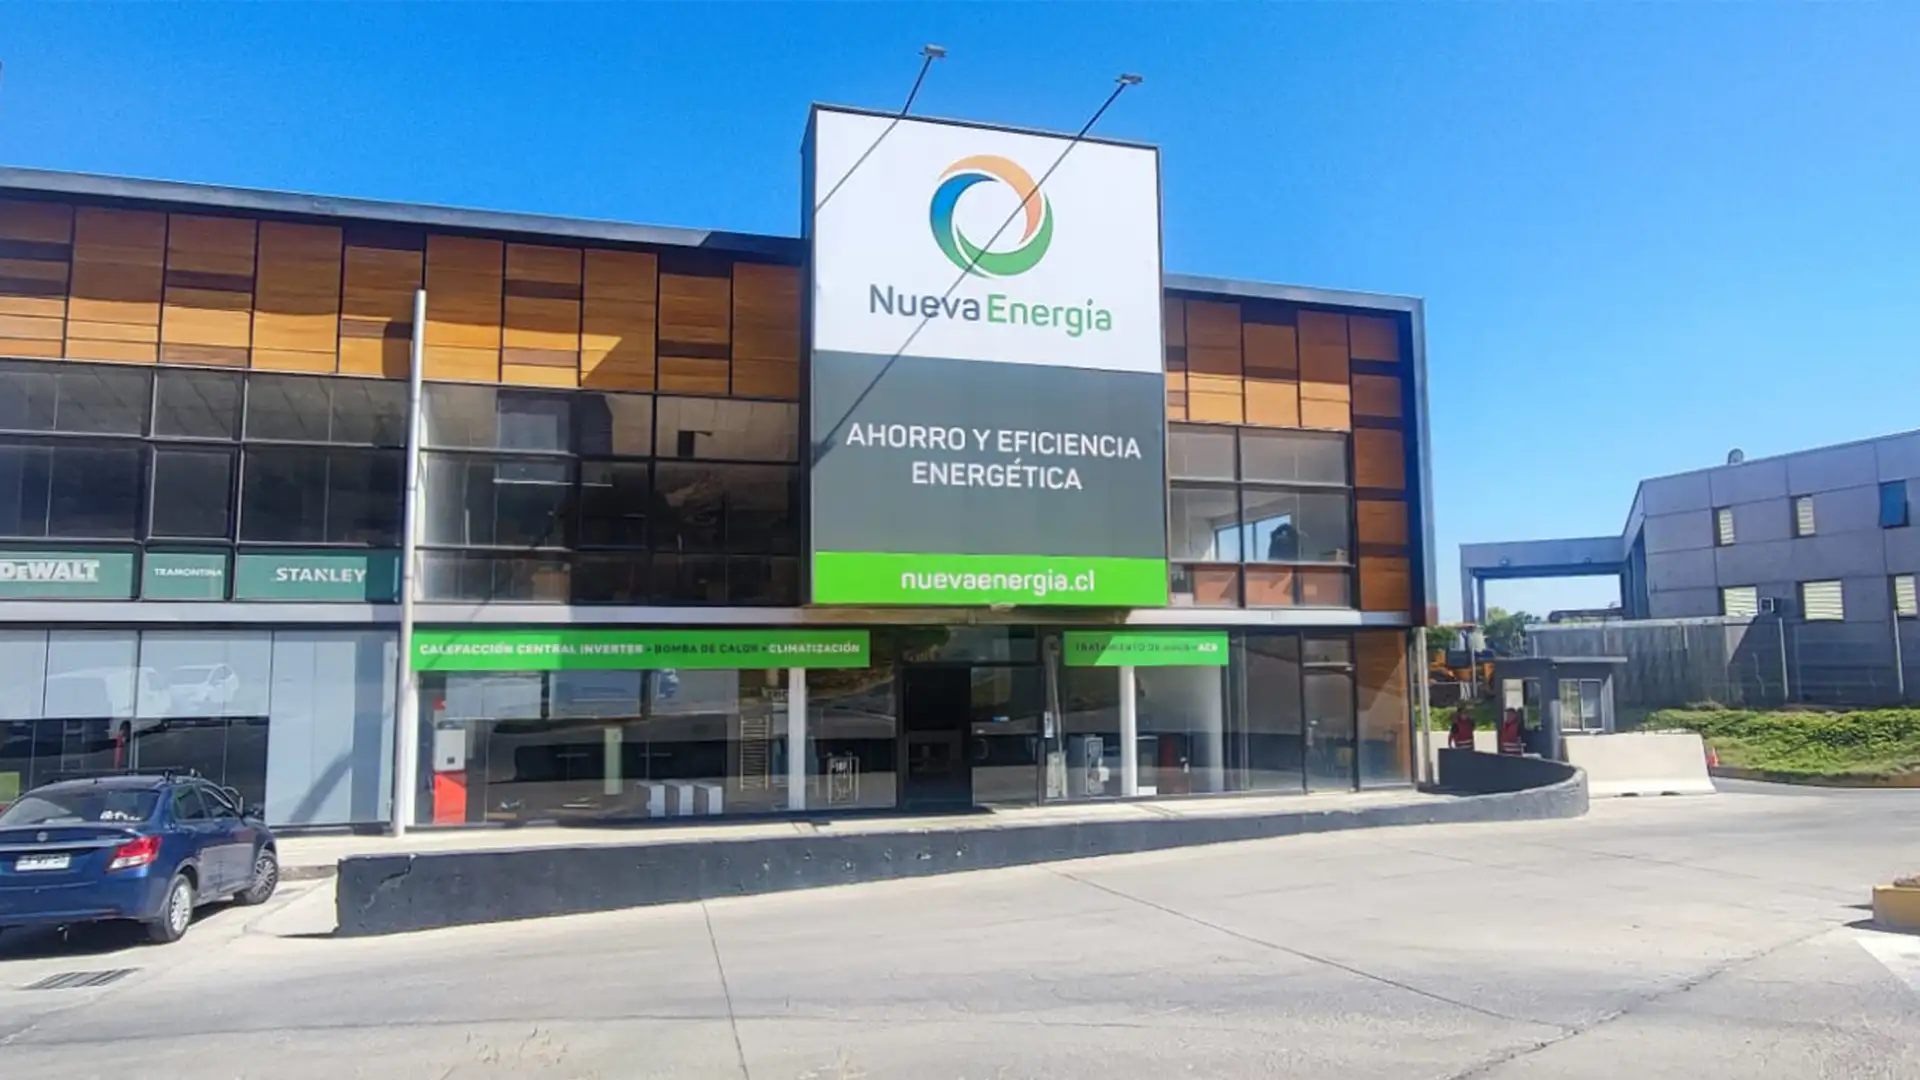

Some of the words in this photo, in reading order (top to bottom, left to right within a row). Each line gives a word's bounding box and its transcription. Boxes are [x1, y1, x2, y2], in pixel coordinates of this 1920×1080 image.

[869, 284, 980, 321] Nueva
[987, 294, 1112, 337] Energía
[846, 422, 966, 450] AHORRO
[972, 429, 991, 451] Y
[997, 430, 1142, 459] EFICIENCIA
[912, 457, 1083, 490] ENERGÉTICA
[275, 566, 367, 583] STANLEY
[900, 569, 1095, 597] nuevaenergia.cl
[516, 644, 577, 655] CENTRAL
[701, 643, 716, 654] DE
